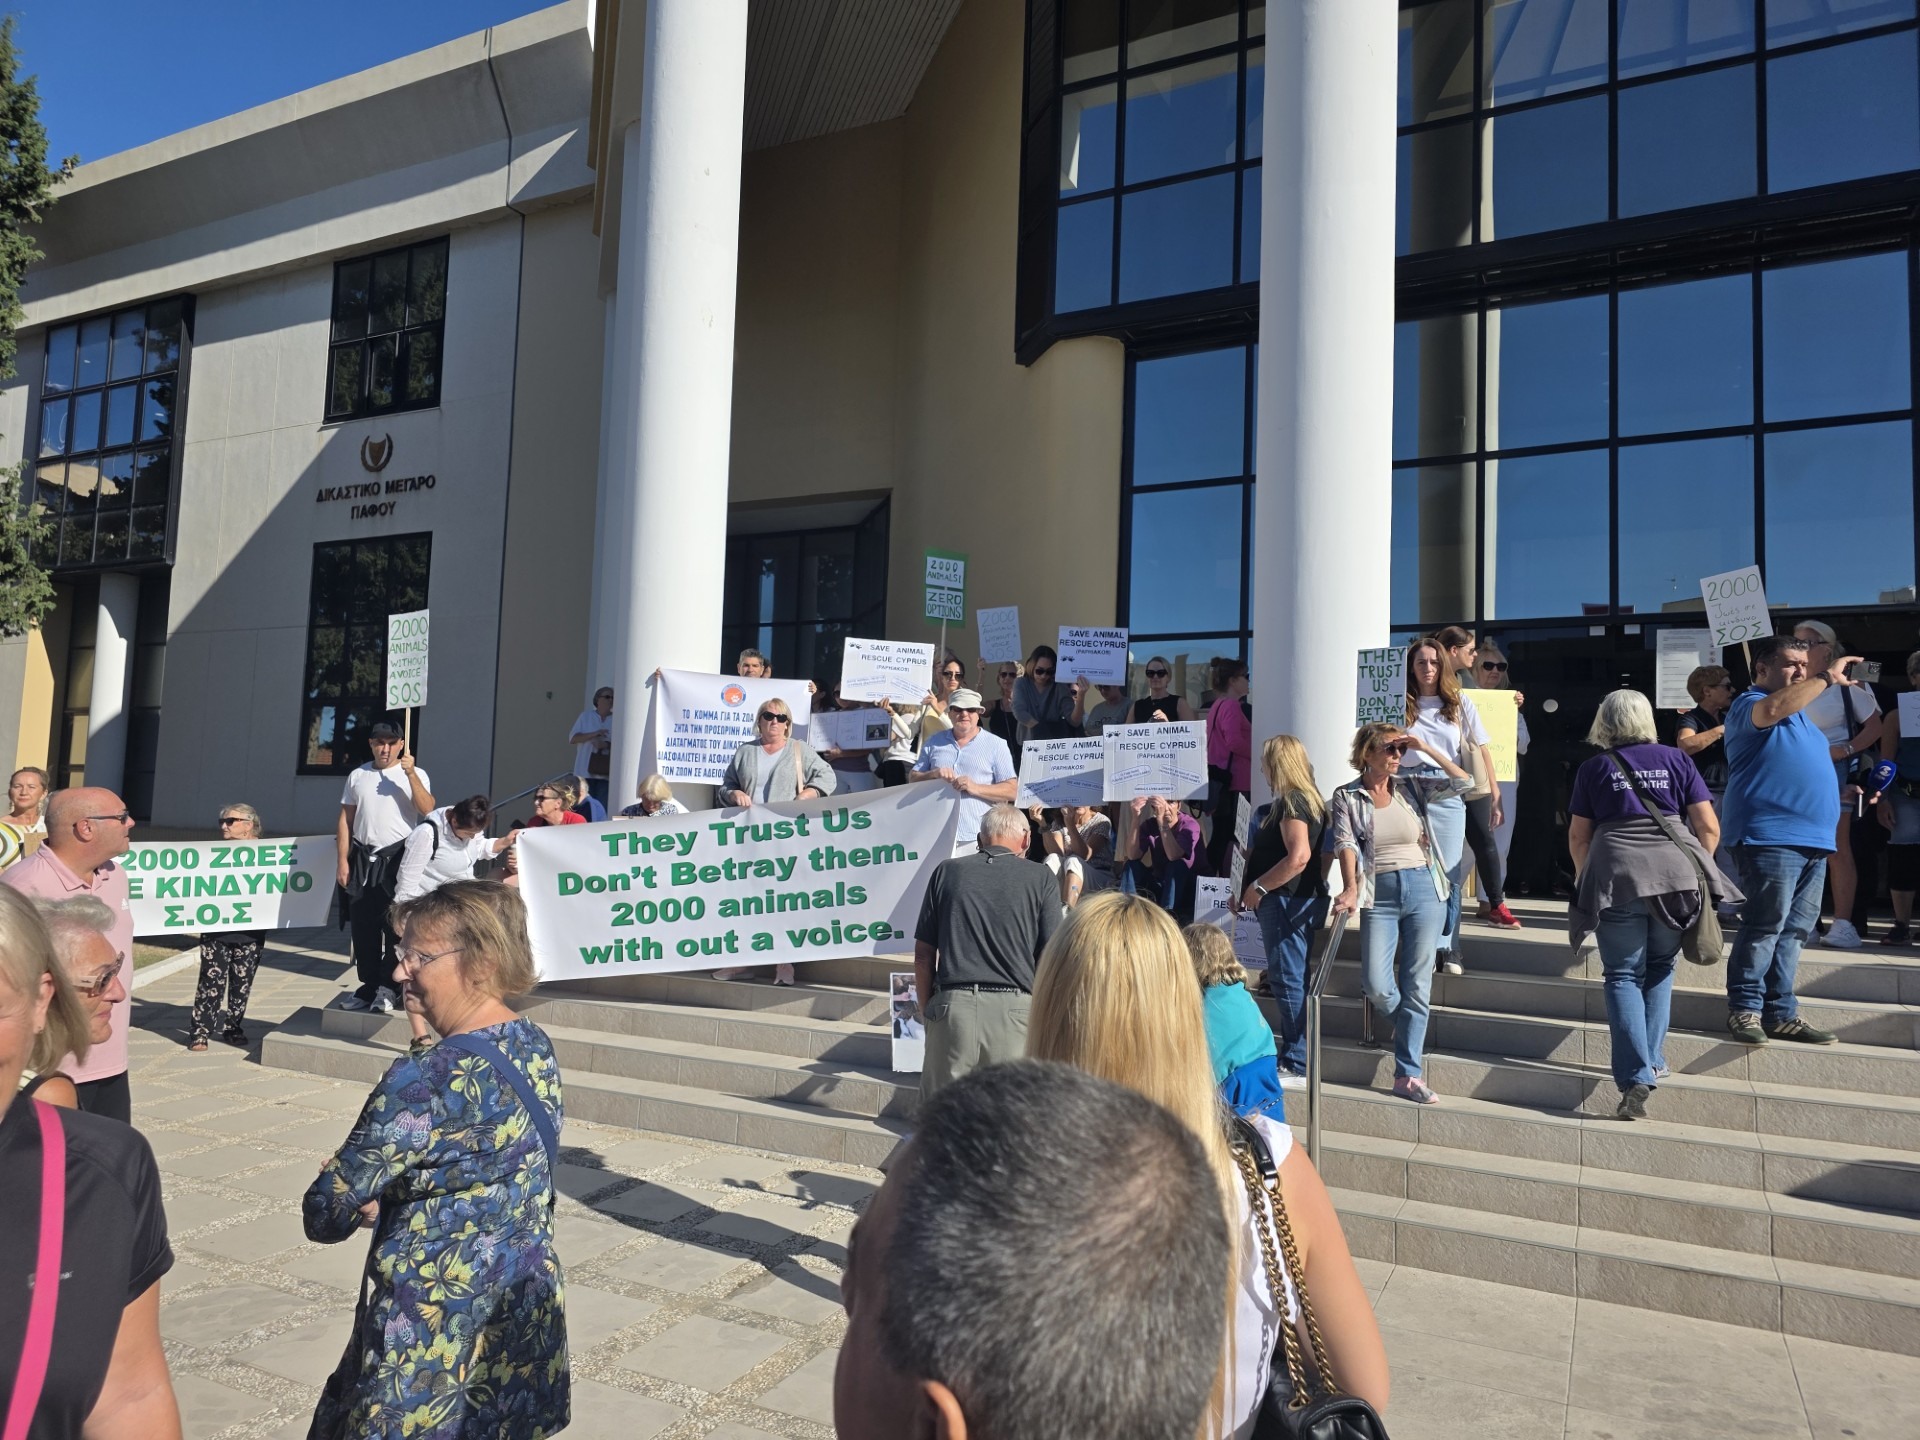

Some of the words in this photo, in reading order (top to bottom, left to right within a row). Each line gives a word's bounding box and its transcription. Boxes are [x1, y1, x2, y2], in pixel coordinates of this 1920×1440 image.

[316, 482, 381, 503] ΔΙΚΑΣΤΙΚΟ
[385, 475, 436, 494] ΜΕΓΑΡΟ
[351, 501, 397, 520] ΠΑΦΟΥ
[930, 560, 958, 573] 2000
[1707, 574, 1760, 601] 2000
[927, 591, 962, 605] ZERO
[927, 603, 961, 618] OPTIONS
[981, 610, 1015, 627] 2000
[390, 616, 429, 641] 2000
[1716, 621, 1765, 646] ΣΟΣ
[389, 639, 428, 654] ANIMALS
[870, 644, 890, 652] SAVE
[390, 656, 427, 667] WITHOUT
[861, 654, 892, 663] RESCUE
[896, 657, 927, 665] CYPRUS
[1358, 647, 1406, 664] THEY
[1359, 664, 1402, 679] TRUST
[1372, 678, 1389, 692] US
[389, 682, 421, 706] SOS
[1359, 694, 1403, 707] DON'T
[682, 709, 690, 719] ΤΟ
[694, 709, 718, 720] ΚΟΜΜΑ
[720, 711, 731, 721] ΓΙΑ
[732, 712, 740, 722] ΤΑ
[742, 712, 754, 722] ΖΩΑ
[1358, 705, 1404, 717] BETRAY
[673, 723, 689, 733] ΖΗΤΑ
[690, 724, 702, 734] ΤΗΝ
[704, 724, 740, 735] ΠΡΟΣΩΡΙΝΗ
[1127, 729, 1150, 737] SAVE
[1157, 726, 1190, 734] ANIMAL
[665, 737, 707, 749] ΔΙΑΤΑΓΜΑΤΟΣ
[709, 739, 721, 749] ΤΟΥ
[1073, 740, 1102, 749] ANIMAL
[1160, 741, 1197, 749] CYPRUS
[701, 753, 707, 762] Η
[1038, 753, 1069, 761] RESCUE
[662, 766, 675, 776] ΤΩΝ
[675, 766, 692, 777] ΖΩΩΝ
[694, 768, 702, 777] ΣΕ
[1611, 770, 1669, 780] VONTEER
[600, 831, 698, 857] They
[709, 813, 810, 846] Trust
[822, 808, 872, 833] Us
[119, 848, 200, 871] 2000
[209, 845, 298, 868] ΖΩΕΣ
[558, 865, 657, 896] Don't
[671, 855, 797, 886] Betray
[808, 843, 918, 872] them.
[128, 877, 144, 899] Ε
[156, 871, 313, 899] ΚΙΝΔΥΝΟ
[611, 896, 706, 926] 2000
[718, 881, 867, 917] animals
[164, 902, 252, 927] Σ.Ο.Σ
[579, 936, 663, 965] with
[676, 929, 739, 957] out
[751, 931, 774, 951] a
[786, 919, 904, 948] voice.
